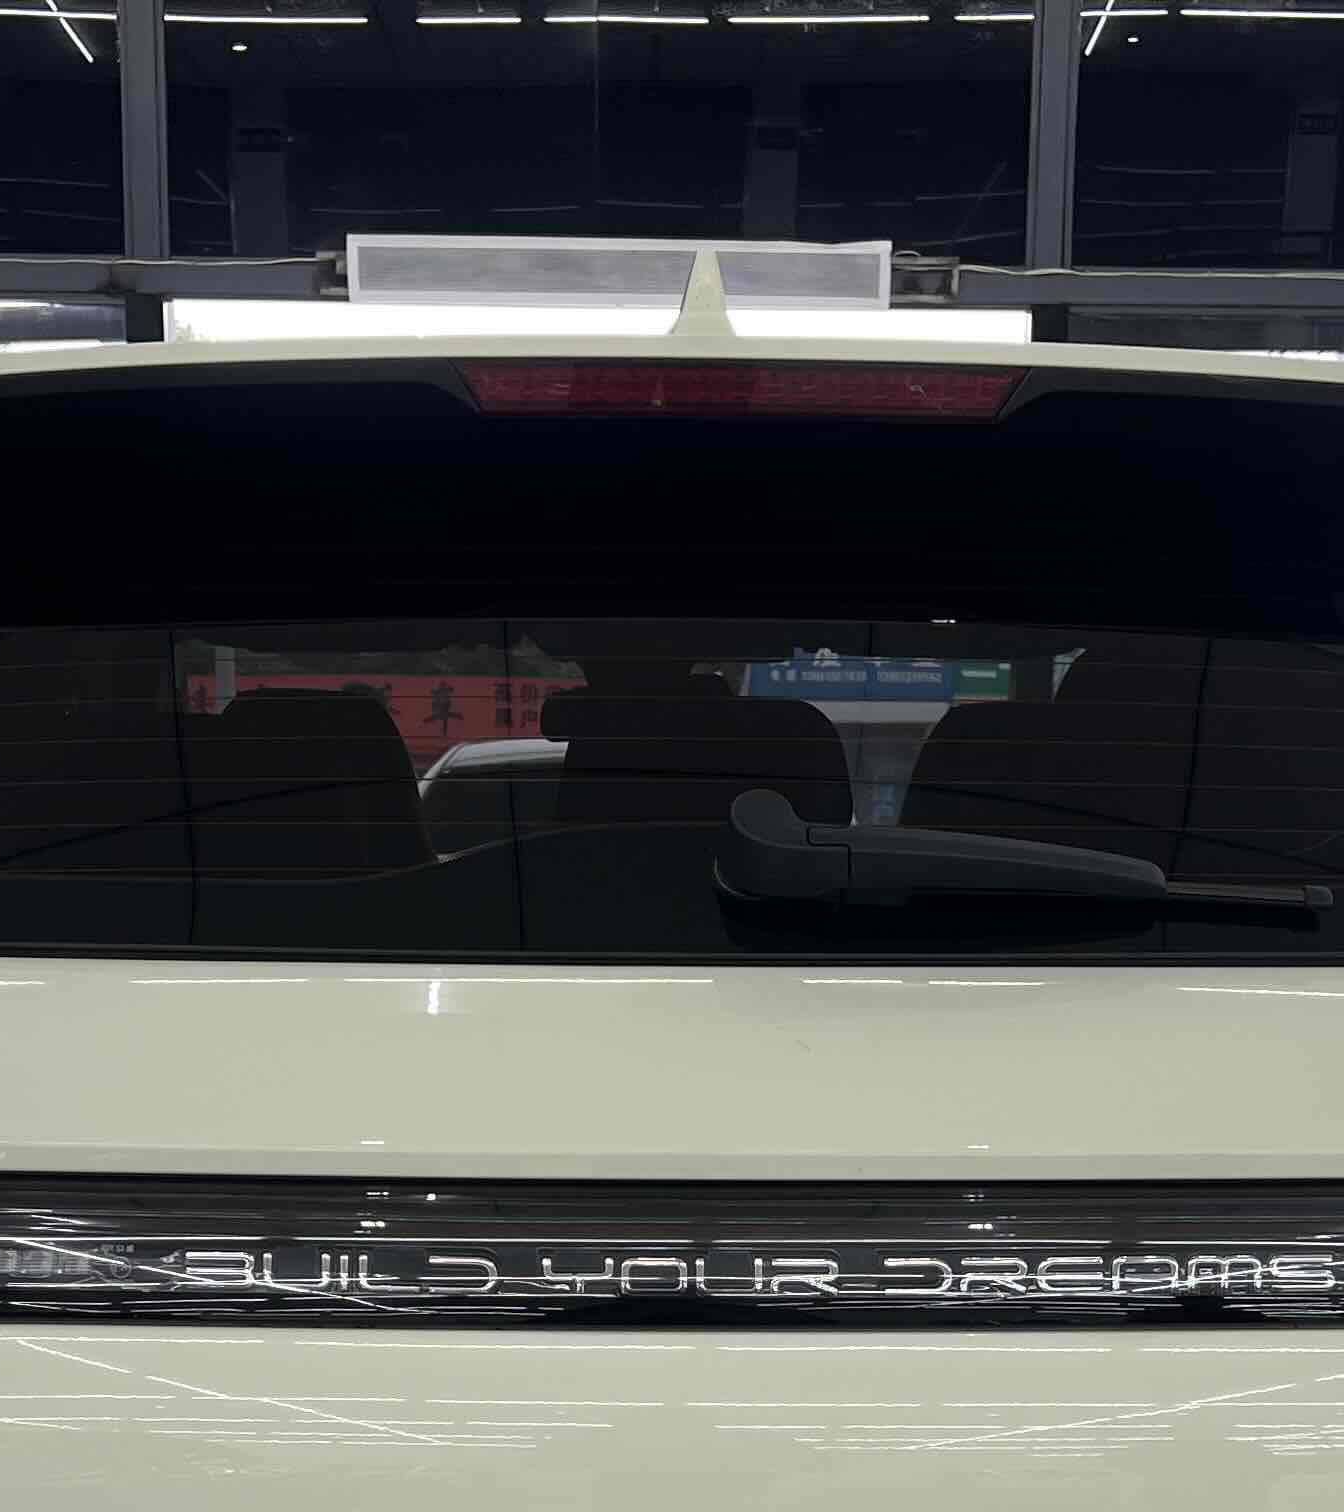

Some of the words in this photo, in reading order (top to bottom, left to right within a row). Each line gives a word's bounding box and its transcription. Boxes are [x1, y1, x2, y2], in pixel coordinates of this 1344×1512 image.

[185, 1251, 499, 1293] BUILD
[541, 1257, 840, 1294] YOUR
[882, 1254, 1336, 1294] DREAMS
